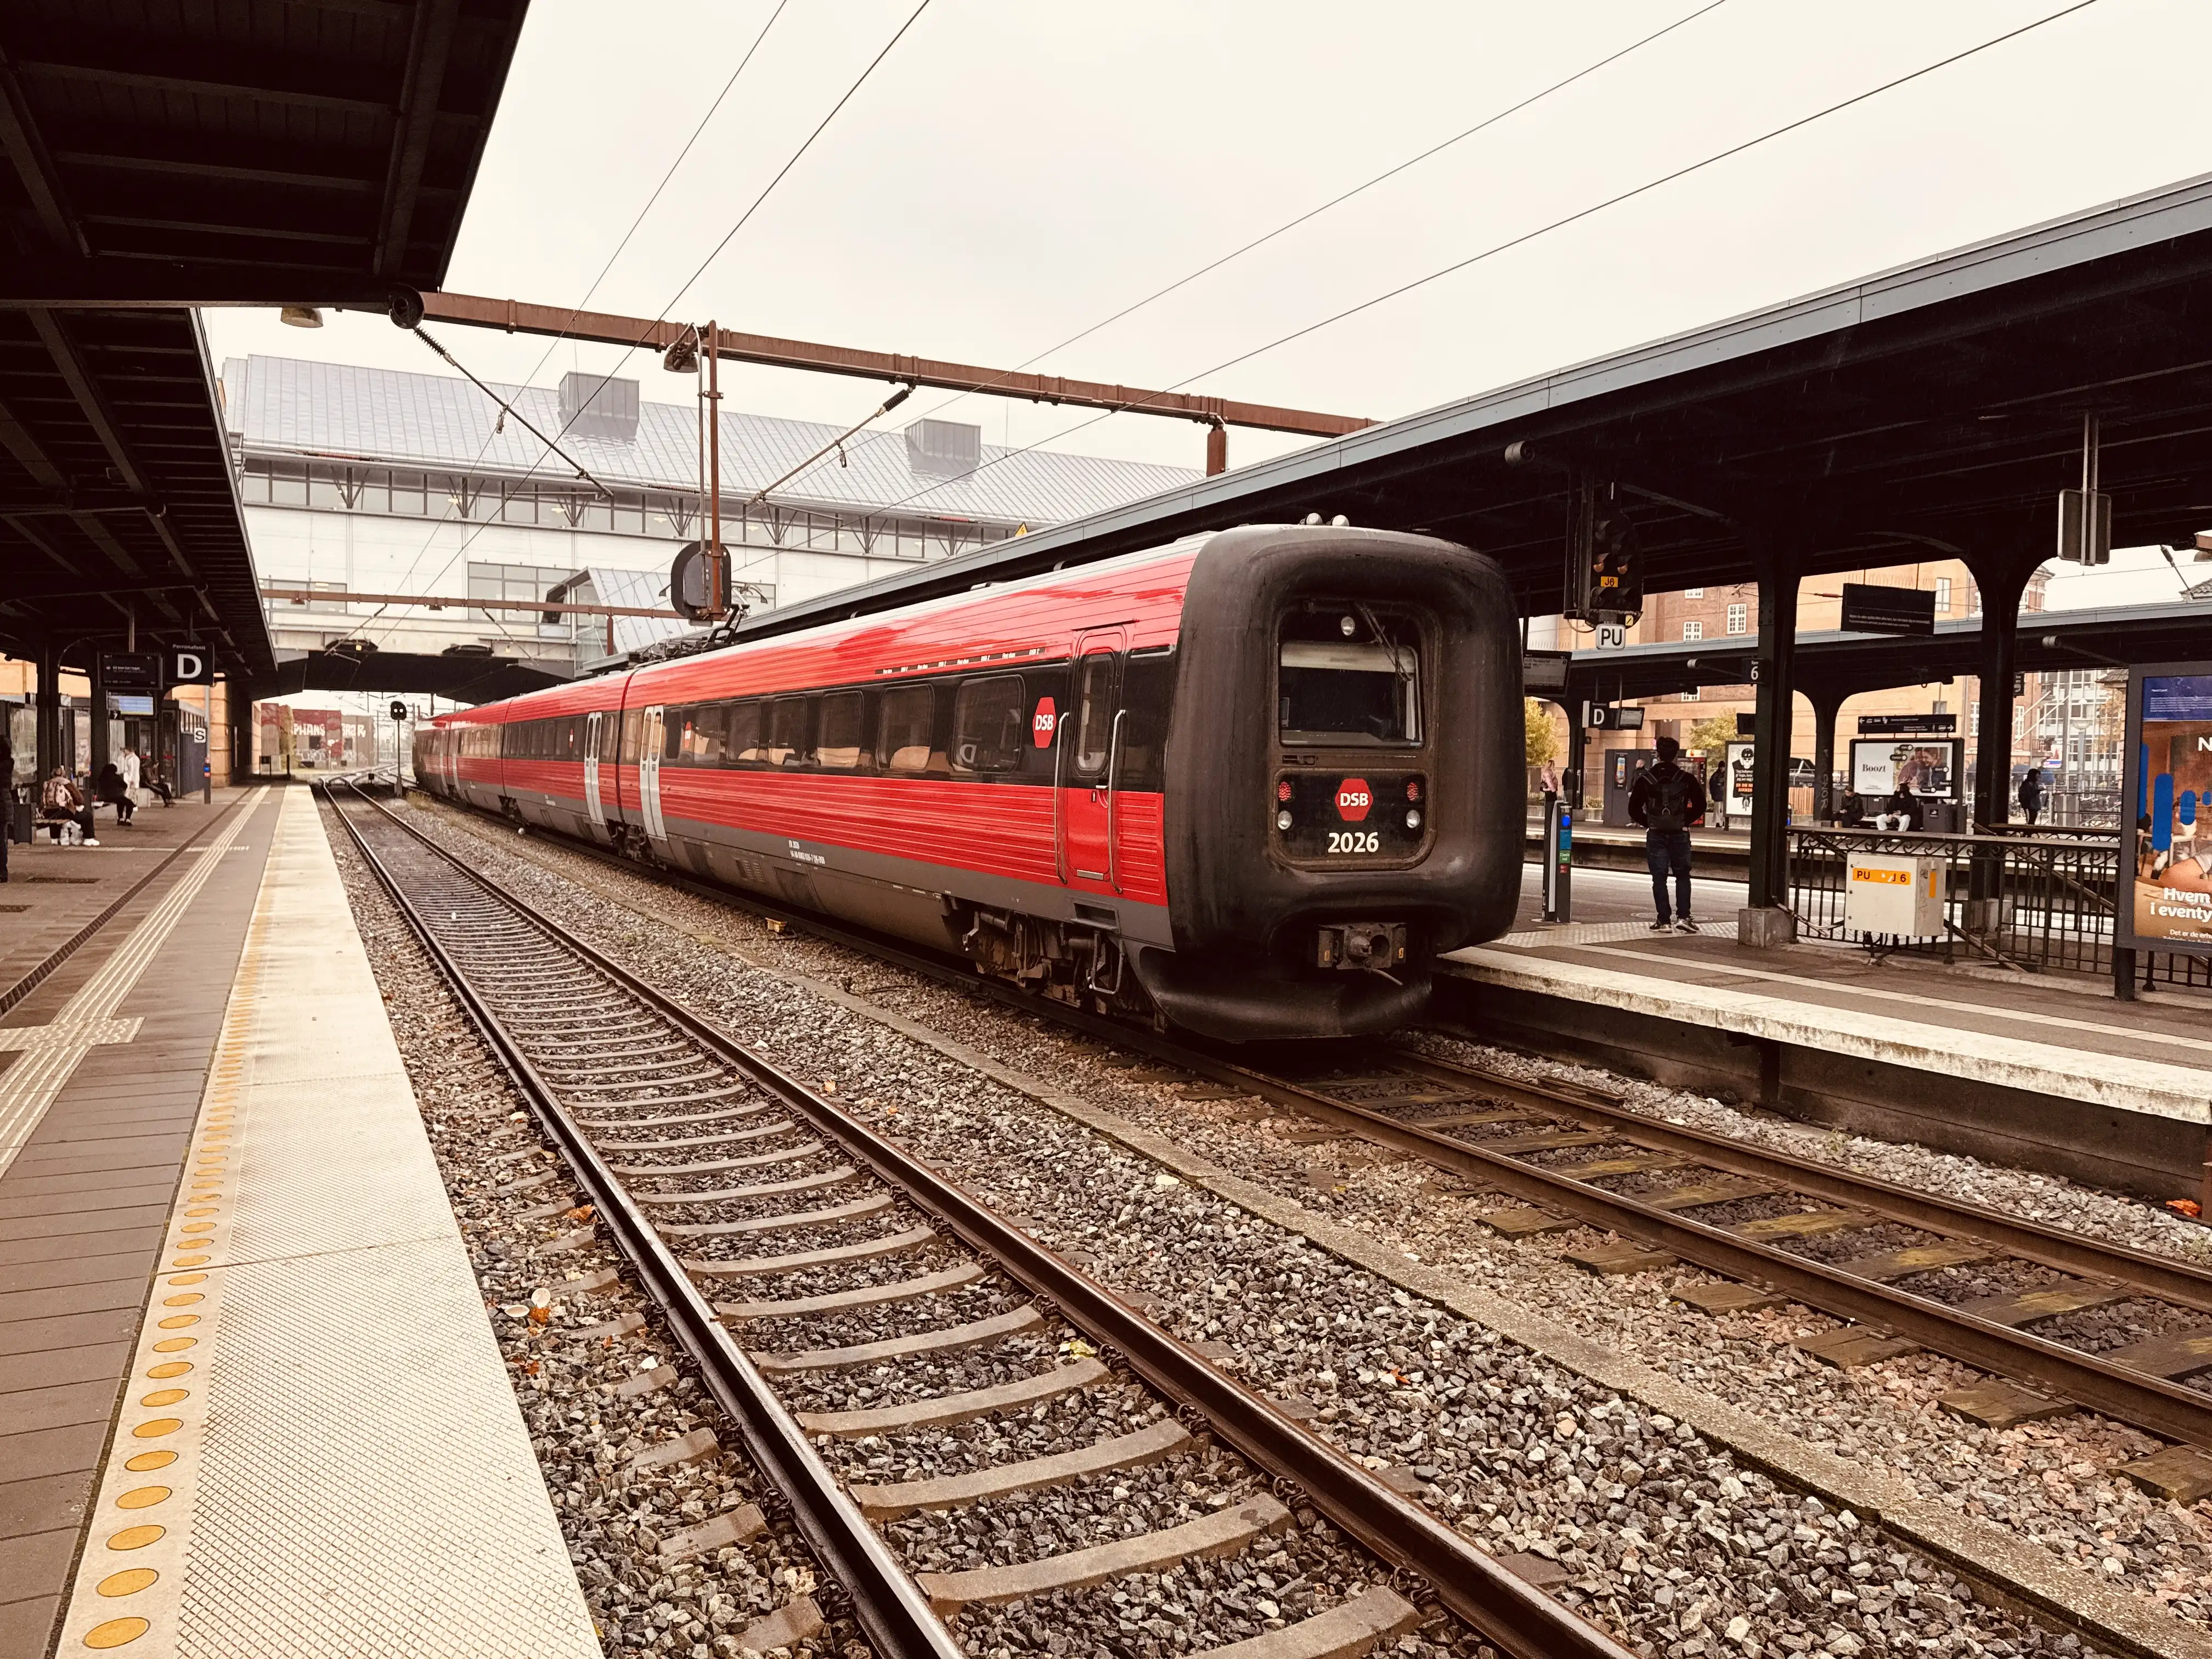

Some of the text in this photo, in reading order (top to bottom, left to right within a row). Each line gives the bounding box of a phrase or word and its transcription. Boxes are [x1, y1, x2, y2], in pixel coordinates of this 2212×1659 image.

[1605, 577, 1615, 586] J6
[1601, 628, 1622, 646] PU
[177, 653, 202, 679] D
[1751, 666, 1758, 680] 6
[1035, 714, 1053, 731] DSB
[1594, 709, 1605, 725] D
[195, 730, 204, 740] S
[1862, 764, 1887, 772] Boozt
[1340, 793, 1369, 806] DSB
[1328, 832, 1379, 853] 2026
[1857, 870, 1870, 879] PU
[1900, 874, 1906, 882] 6
[2163, 888, 2211, 904] Hvem
[2151, 901, 2155, 915] i
